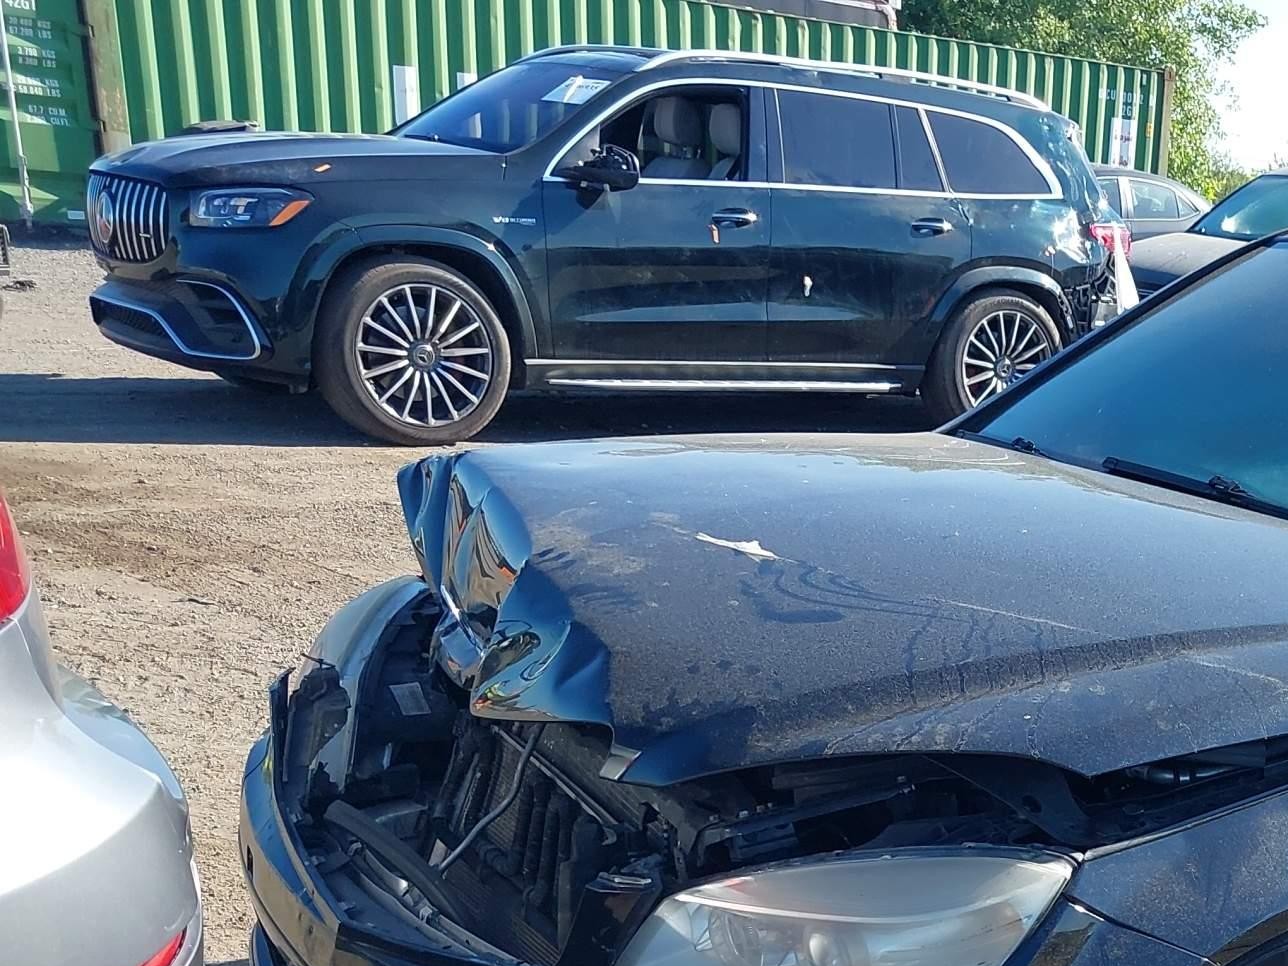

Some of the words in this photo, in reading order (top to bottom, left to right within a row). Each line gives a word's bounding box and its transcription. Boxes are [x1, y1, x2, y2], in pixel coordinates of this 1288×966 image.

[38, 30, 52, 39] LBS
[42, 50, 56, 59] KGS
[42, 60, 56, 68] LBS
[47, 89, 61, 97] LBS
